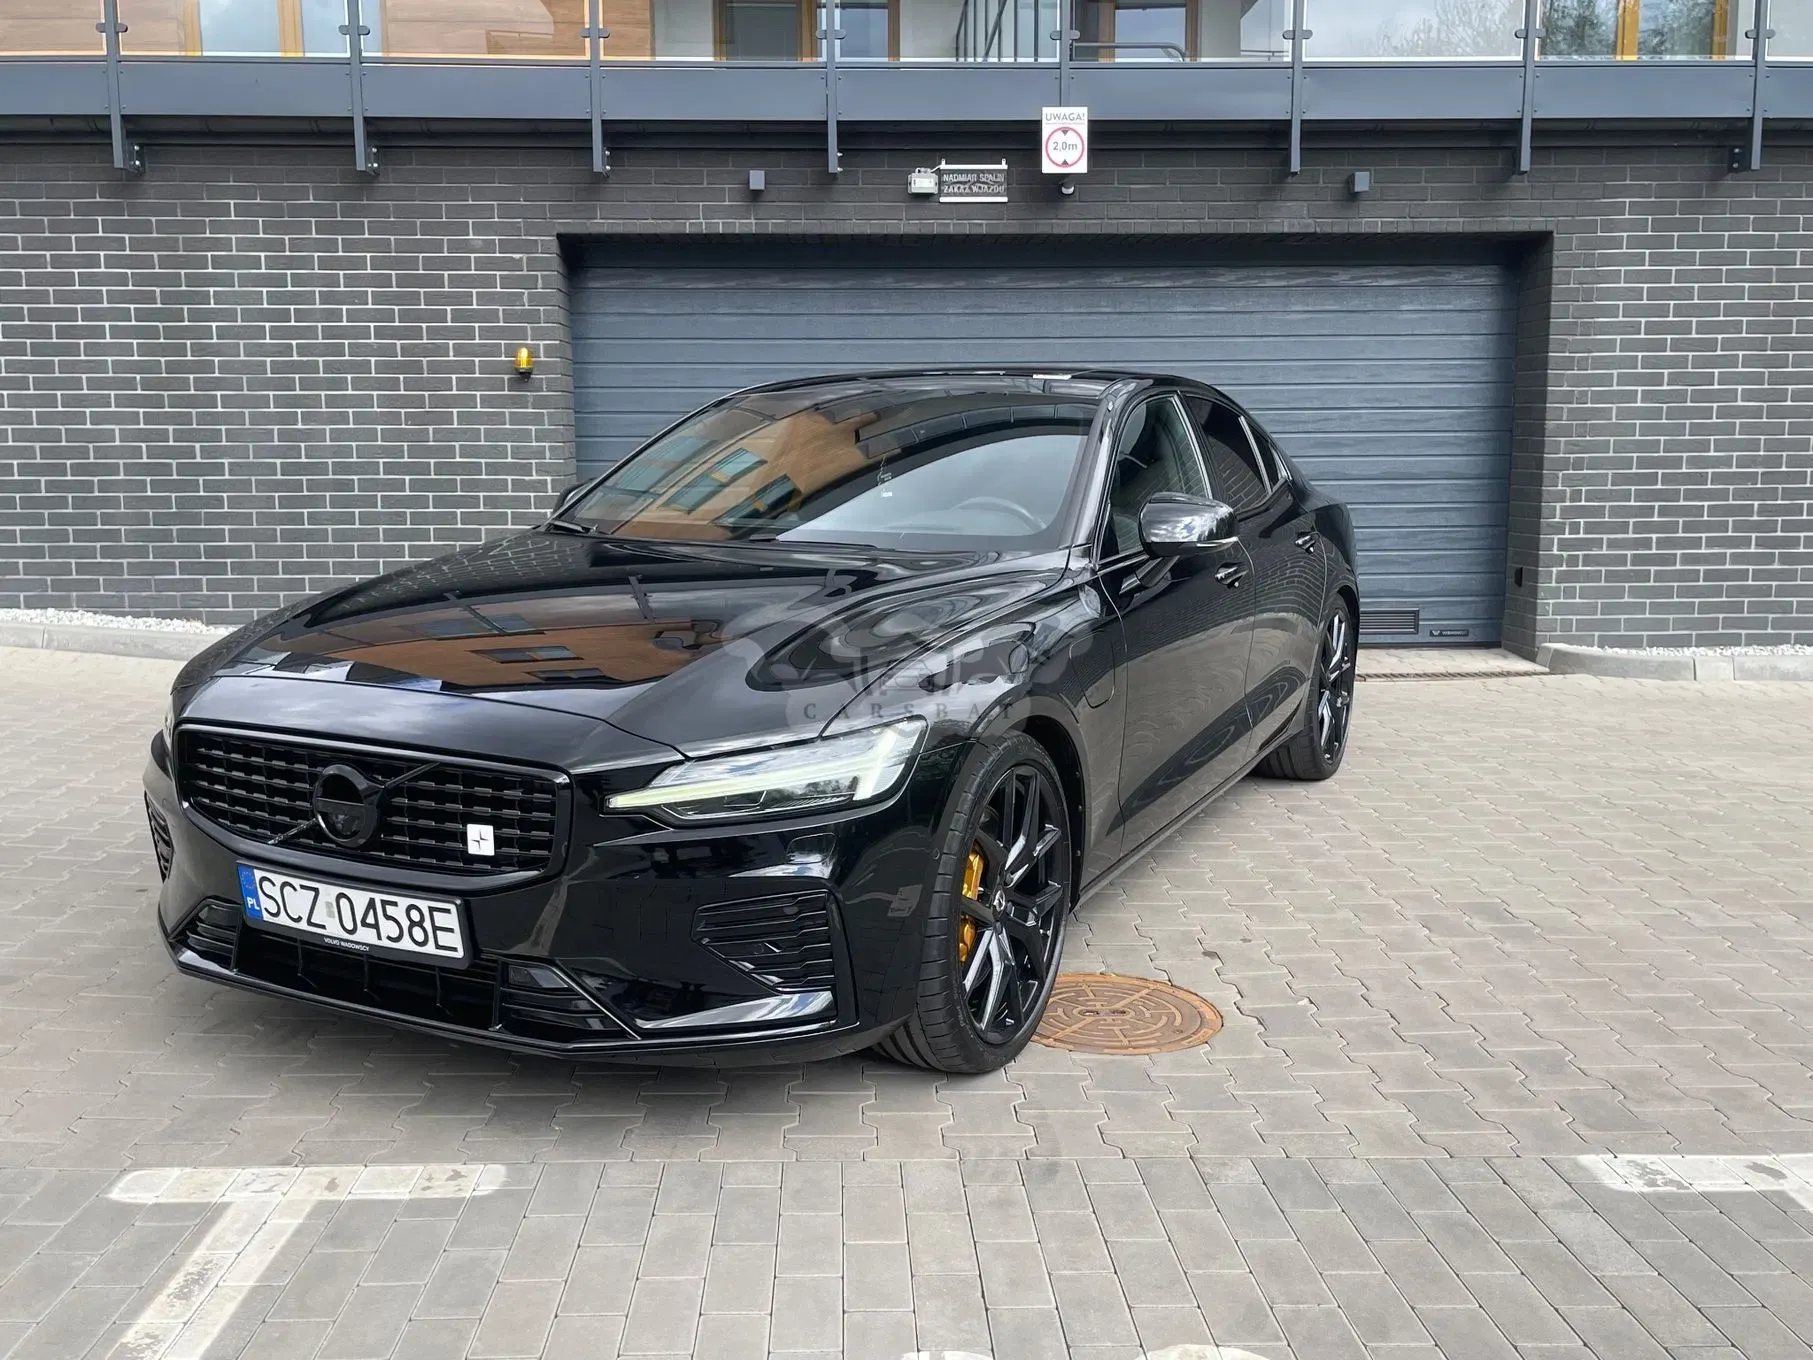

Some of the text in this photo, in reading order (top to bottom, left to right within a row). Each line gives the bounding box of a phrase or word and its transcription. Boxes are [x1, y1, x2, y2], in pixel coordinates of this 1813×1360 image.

[1045, 112, 1085, 121] UWAGA!
[1052, 141, 1078, 151] 2,0m
[943, 173, 977, 182] NADMIAR
[943, 185, 1004, 193] ZAKAZ WJAZDU
[247, 897, 260, 911] PL
[258, 876, 459, 953] SCZ 0458E
[323, 937, 340, 946] VOLVO
